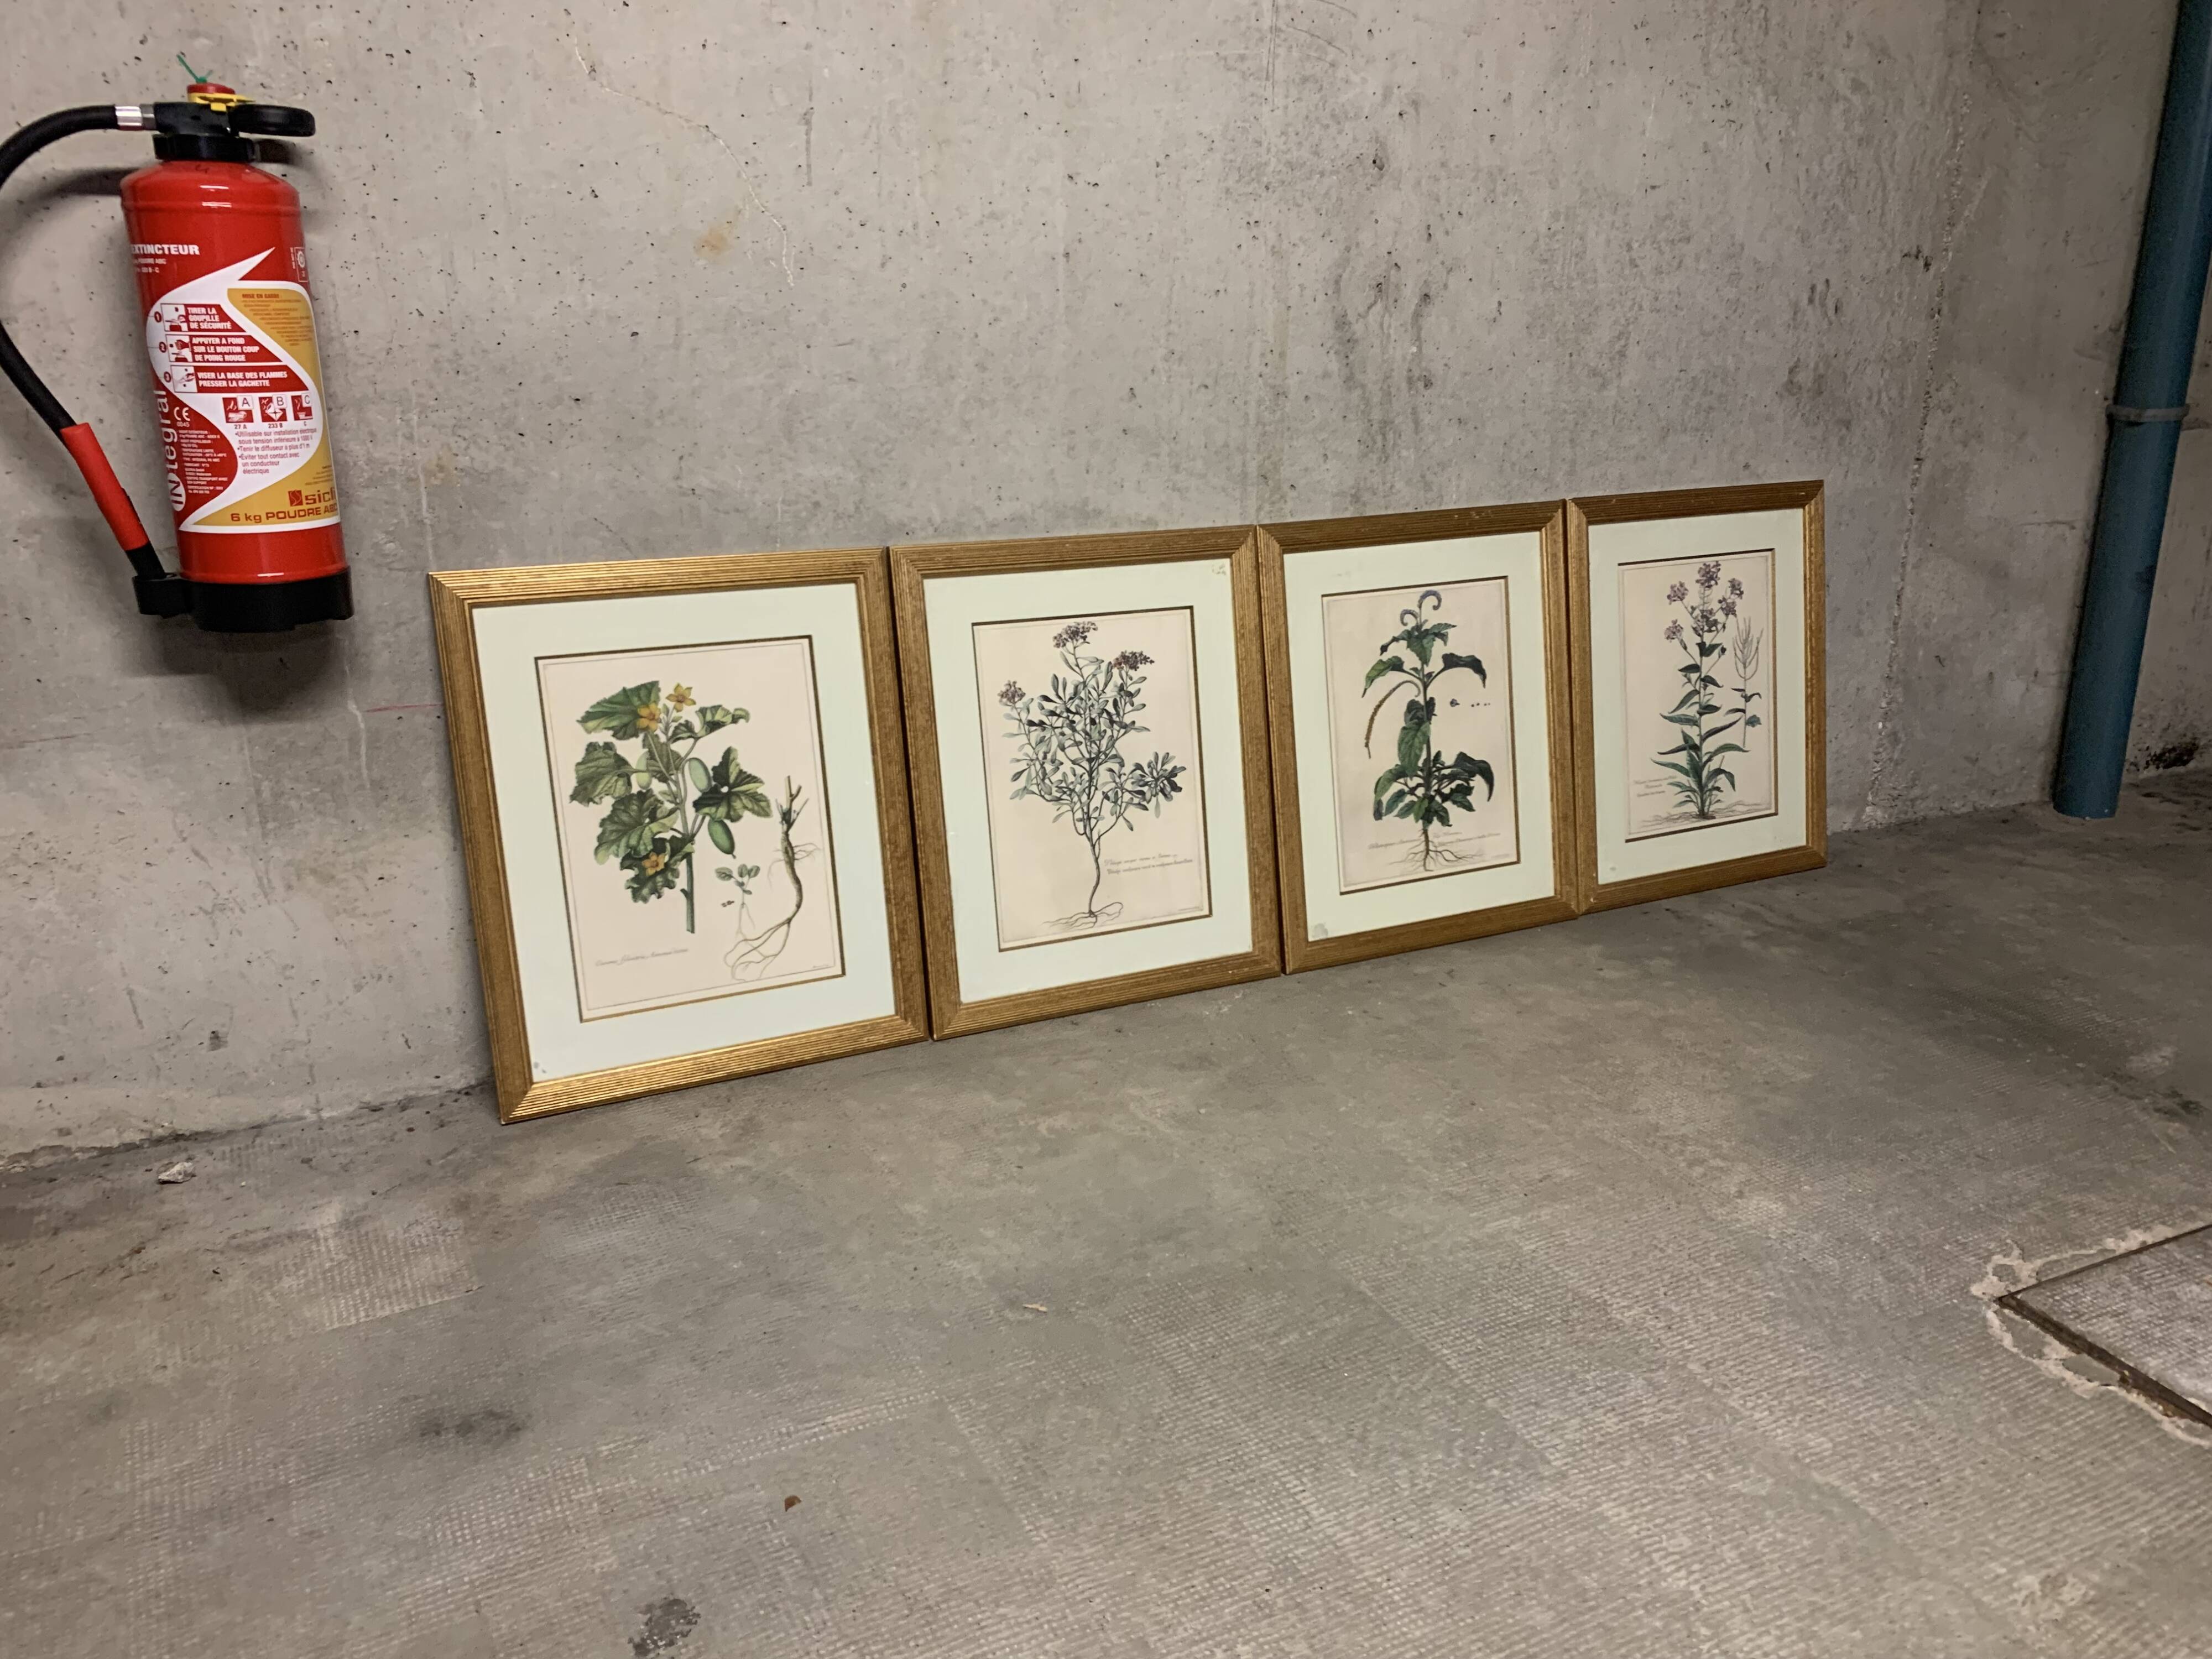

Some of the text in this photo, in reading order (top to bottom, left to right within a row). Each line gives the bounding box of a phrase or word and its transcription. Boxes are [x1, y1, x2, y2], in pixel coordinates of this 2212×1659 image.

[132, 244, 200, 255] EXTINCTEUR
[200, 321, 232, 329] SÉCURITÉ
[242, 398, 251, 407] A
[276, 397, 284, 406] B
[304, 395, 310, 404] C
[174, 406, 190, 421] CE
[231, 513, 240, 521] 6
[244, 513, 262, 523] kg
[265, 507, 321, 520] POUDRE
